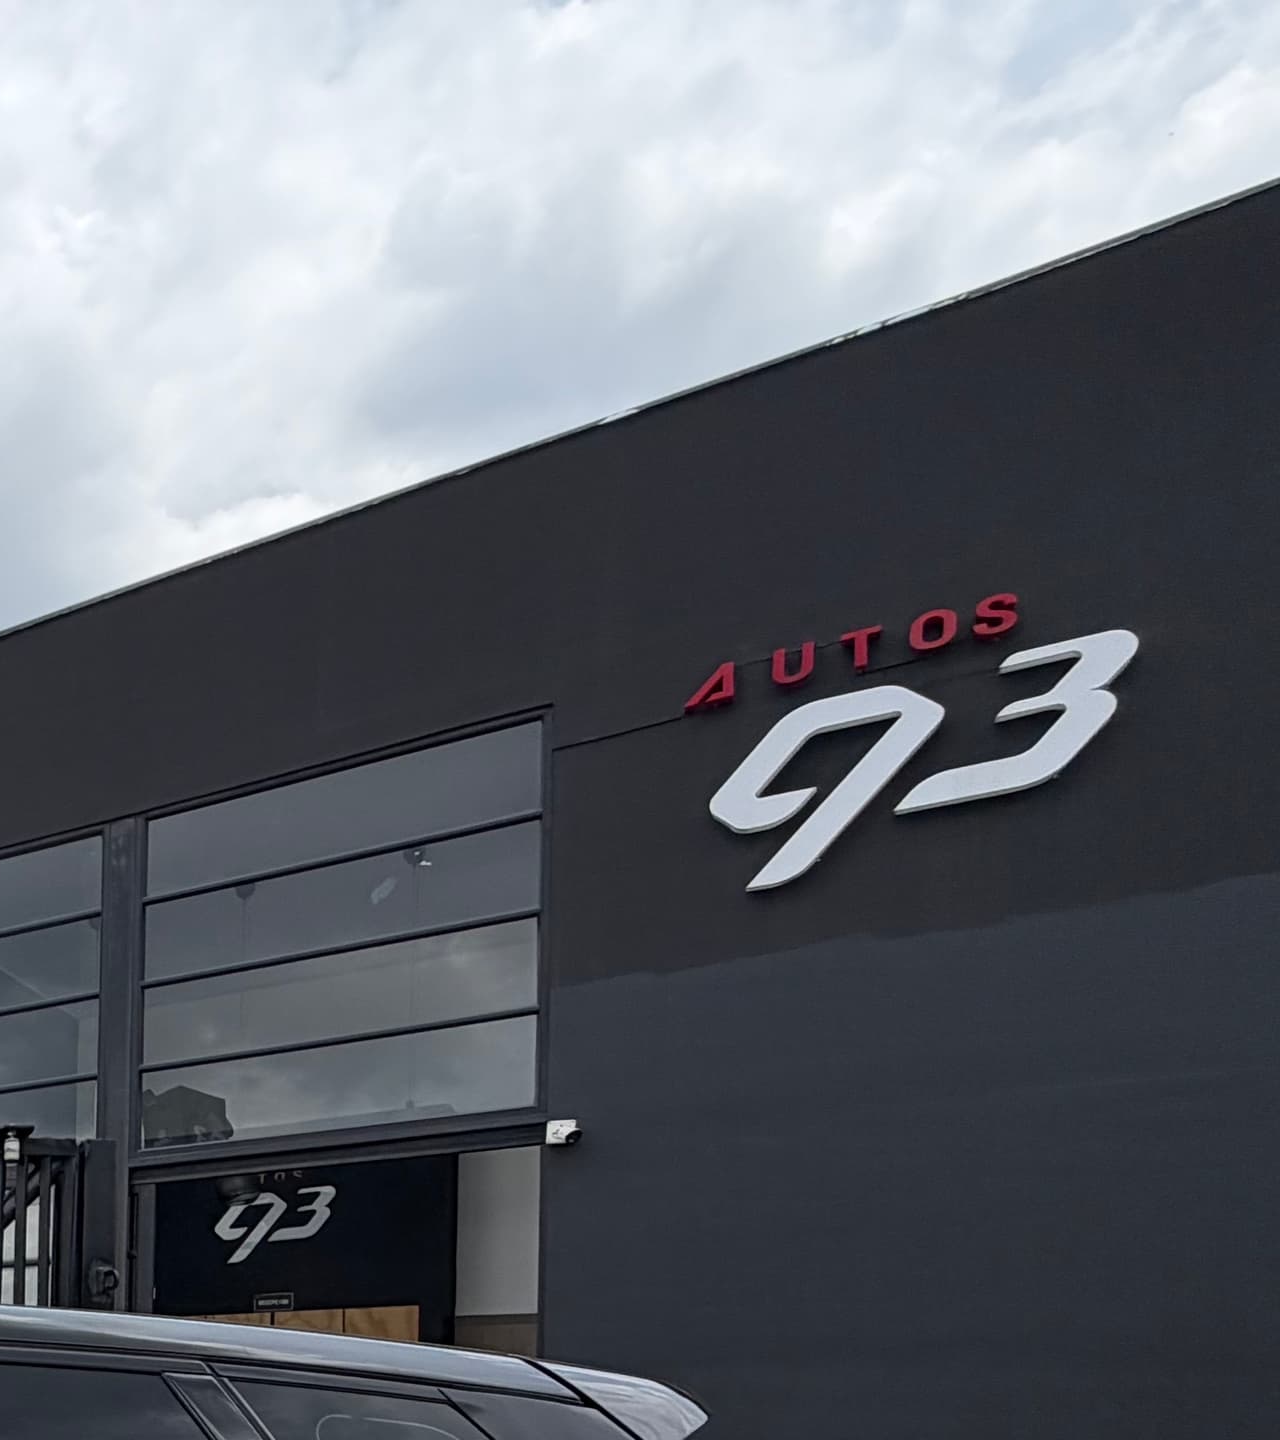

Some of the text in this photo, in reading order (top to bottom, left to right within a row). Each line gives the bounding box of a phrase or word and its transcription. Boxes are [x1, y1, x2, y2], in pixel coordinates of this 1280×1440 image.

[684, 593, 1018, 714] AUTOS
[709, 629, 1140, 893] 93
[214, 1185, 337, 1264] 93
